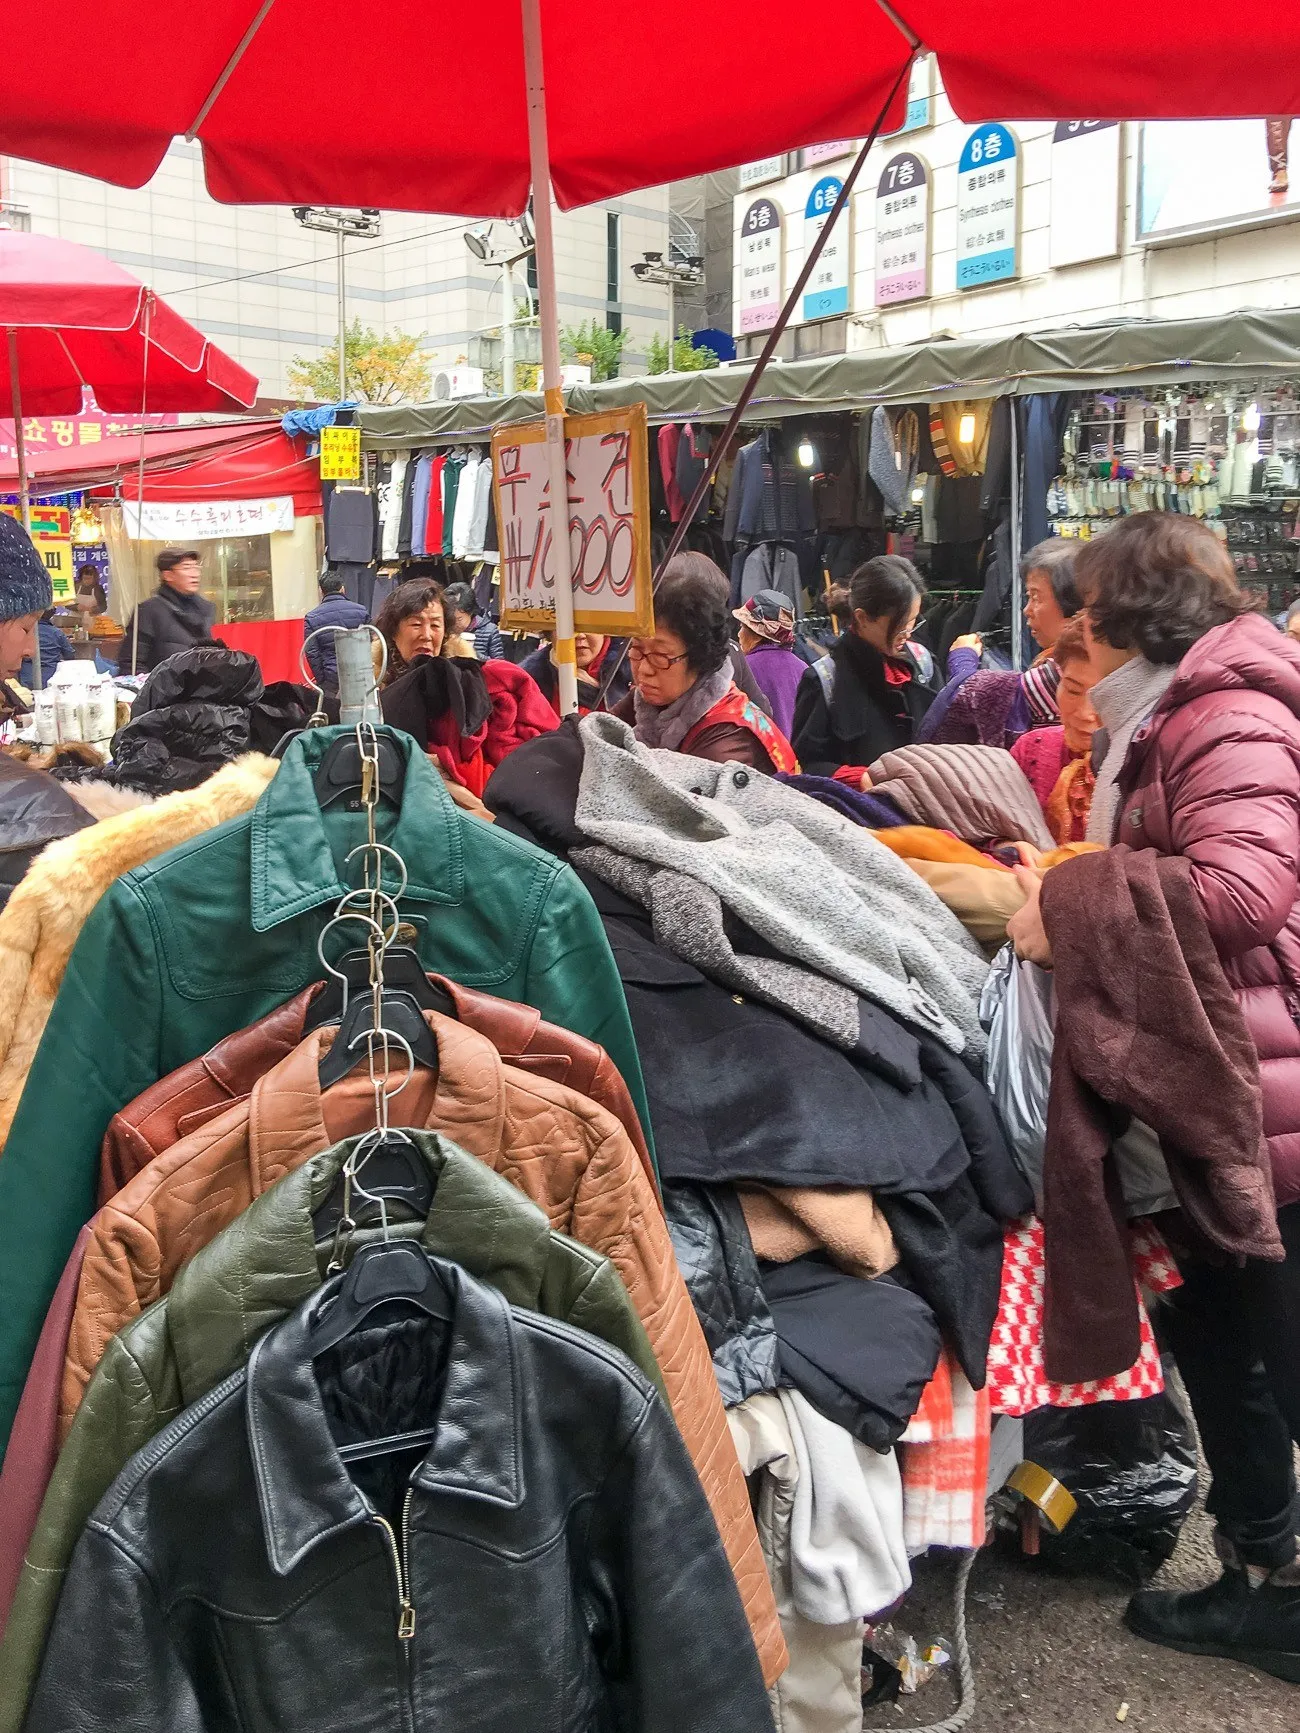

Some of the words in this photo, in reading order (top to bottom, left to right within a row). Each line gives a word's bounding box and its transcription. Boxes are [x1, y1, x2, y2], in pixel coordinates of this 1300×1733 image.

[971, 132, 1002, 163] 8층
[887, 160, 915, 189] 7층
[814, 184, 839, 210] 6층
[748, 205, 771, 230] 5층
[350, 800, 360, 808] 55
